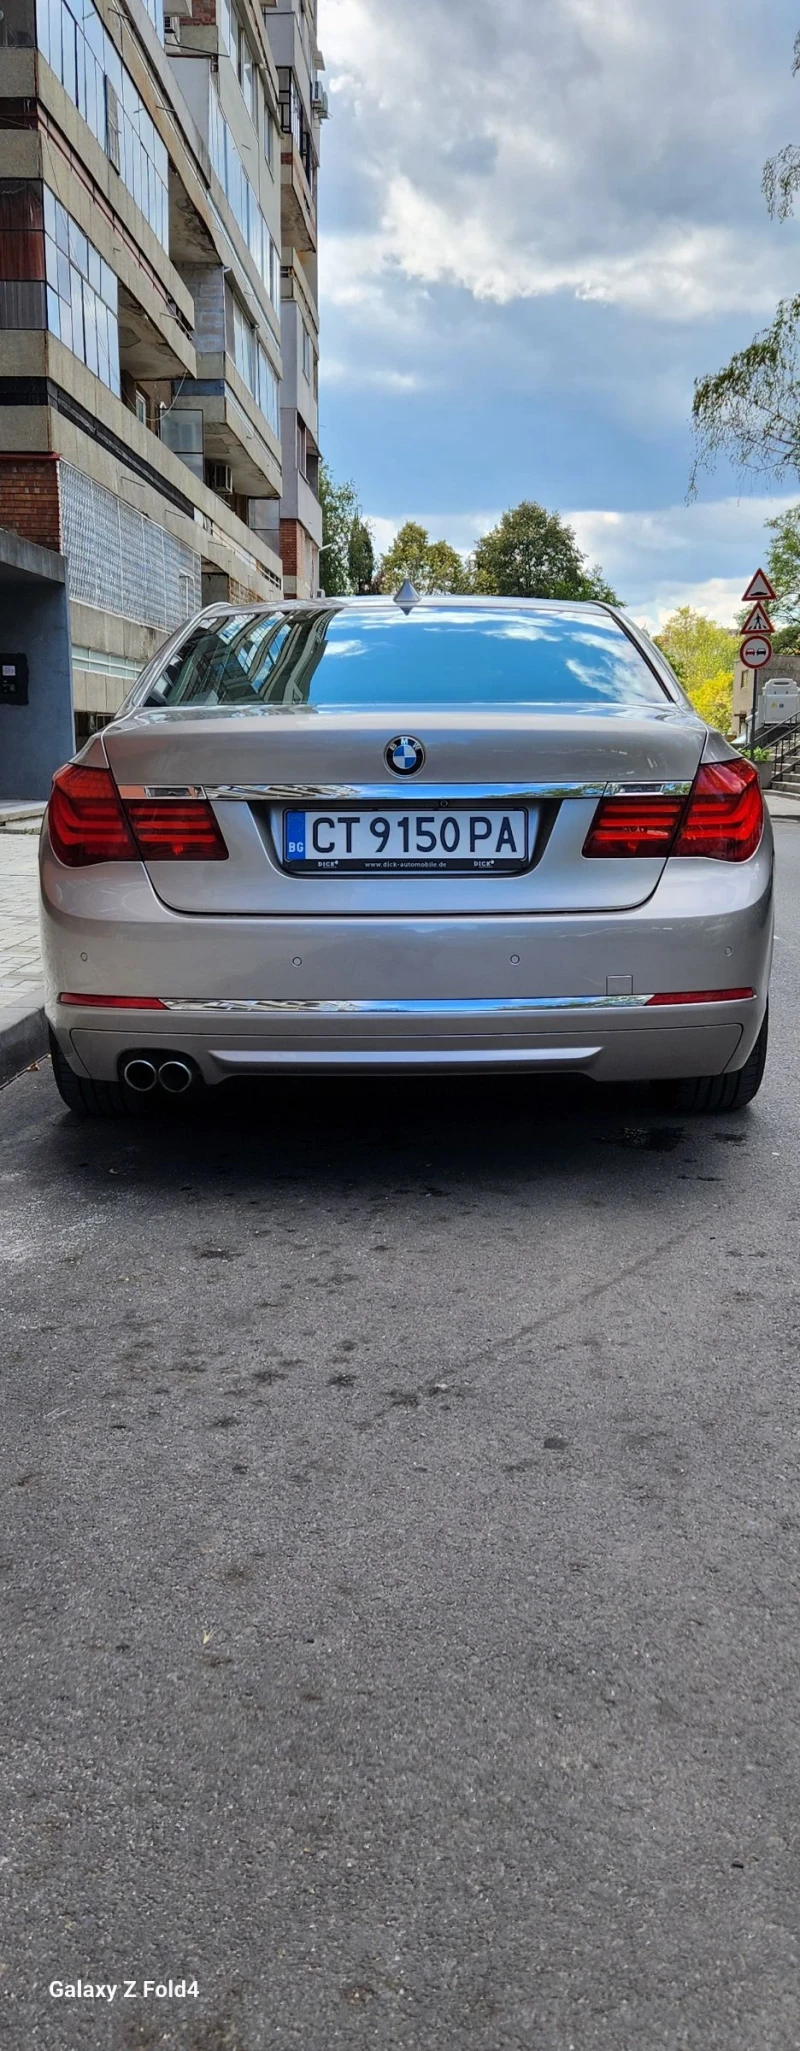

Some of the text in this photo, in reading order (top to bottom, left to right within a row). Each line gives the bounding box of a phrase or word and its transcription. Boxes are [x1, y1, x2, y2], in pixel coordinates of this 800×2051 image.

[390, 737, 421, 750] BMW
[312, 816, 518, 853] CT 9150 PA
[288, 841, 304, 853] BG
